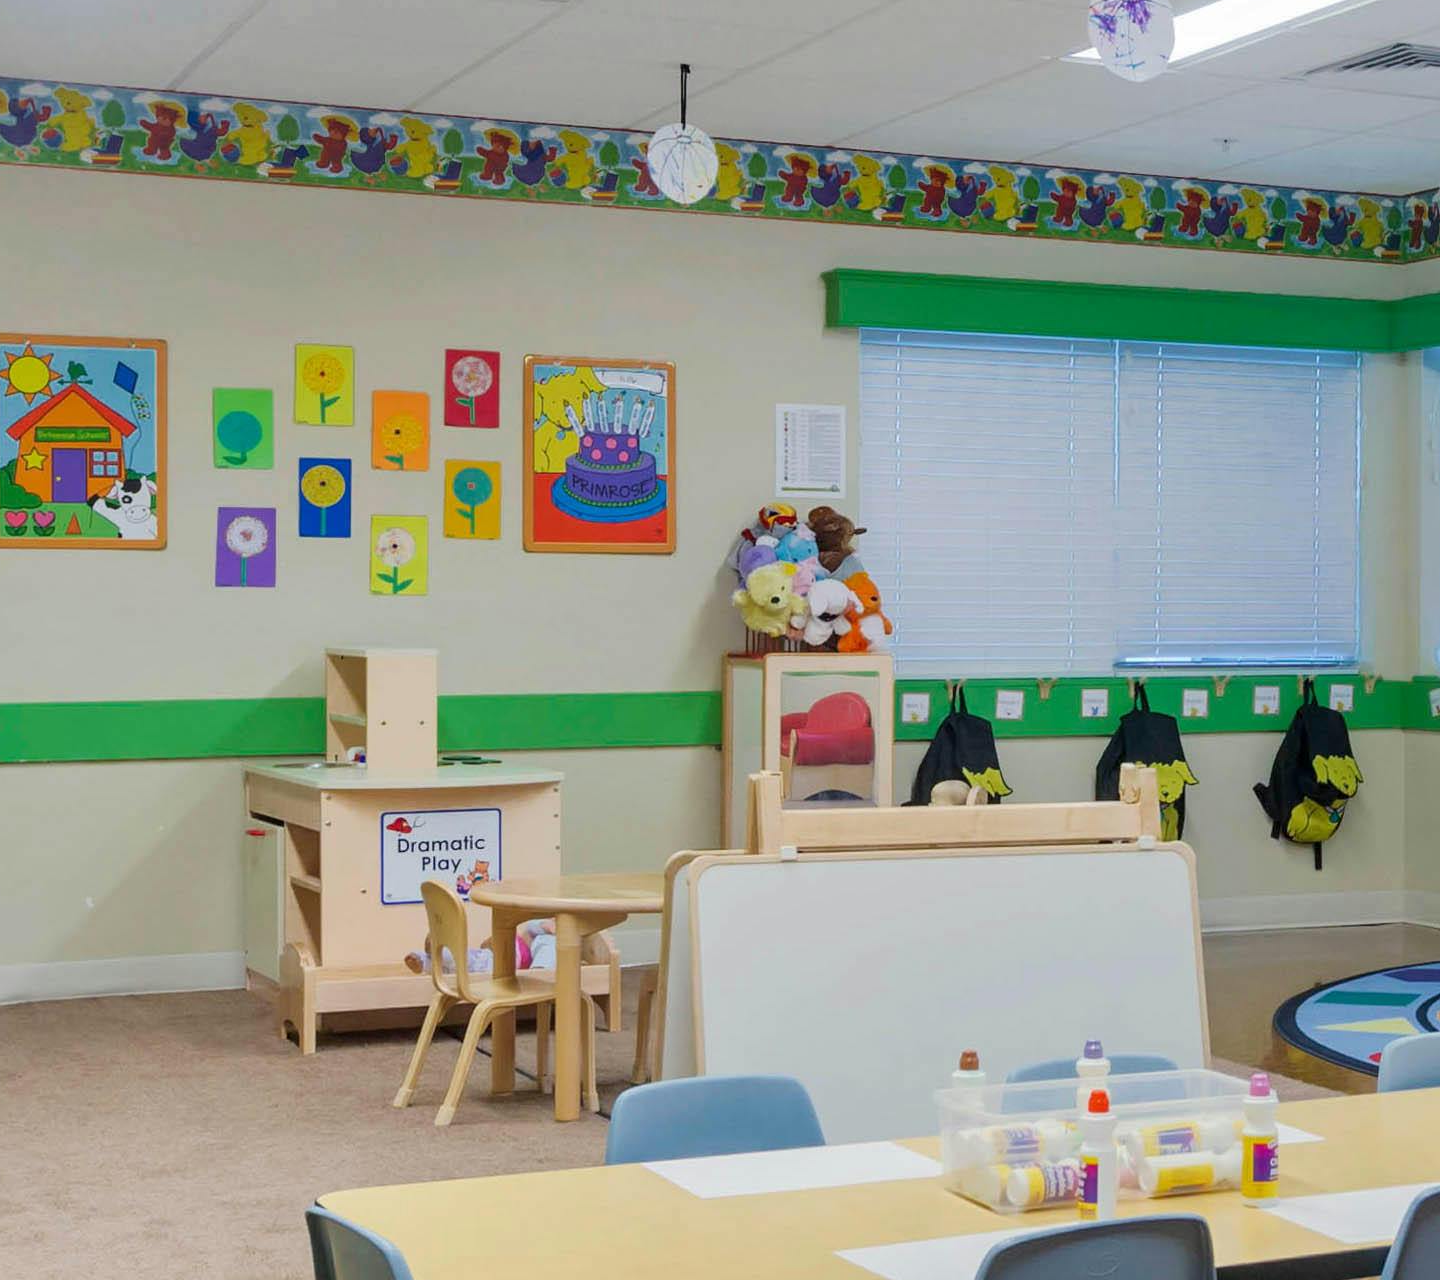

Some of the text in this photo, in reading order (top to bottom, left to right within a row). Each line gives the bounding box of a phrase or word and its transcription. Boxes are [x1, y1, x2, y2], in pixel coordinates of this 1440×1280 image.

[572, 473, 652, 498] PRIMROSE
[397, 835, 486, 853] Dramatic
[421, 856, 462, 874] Play
